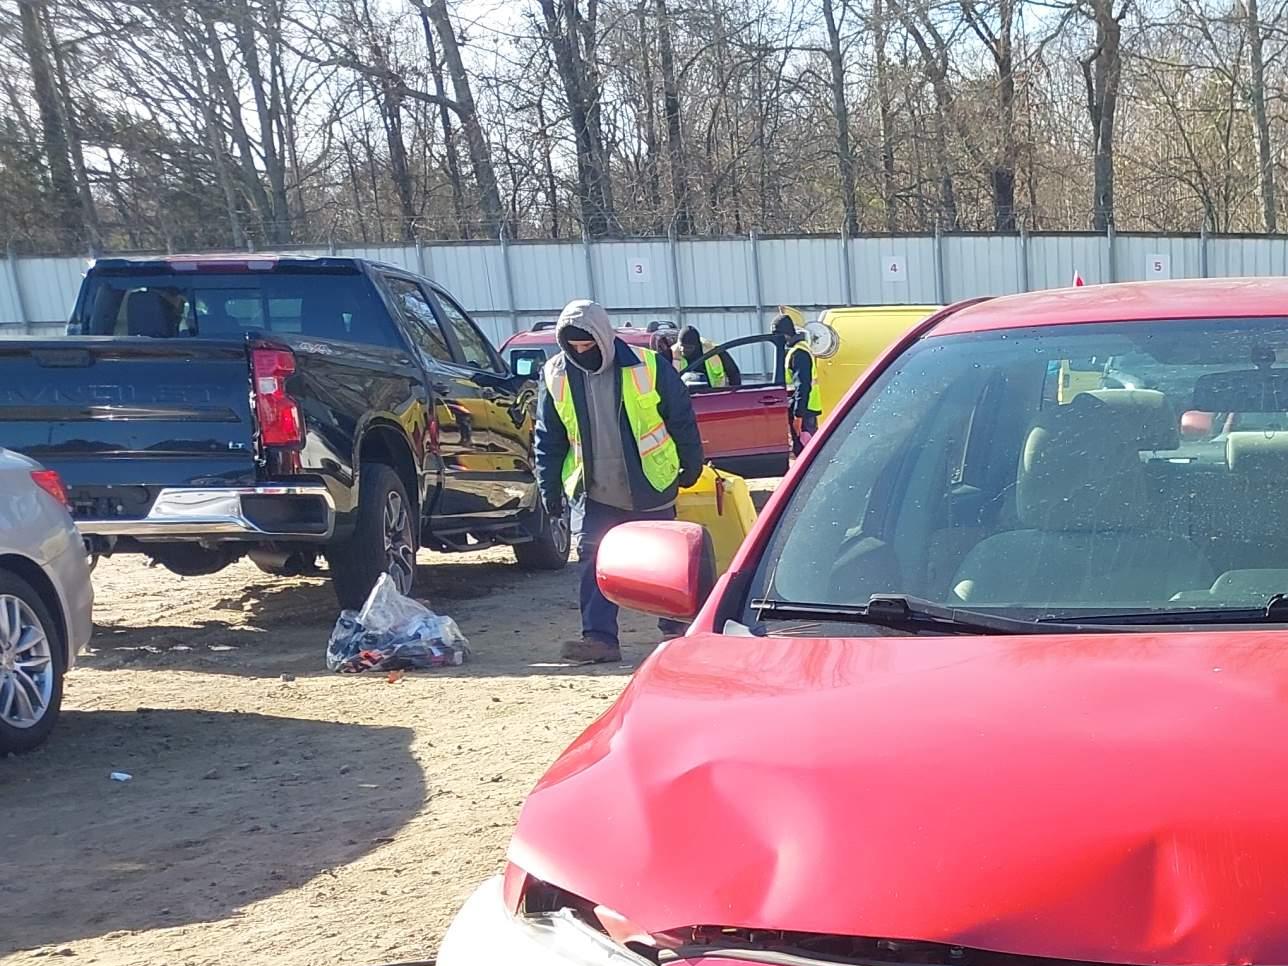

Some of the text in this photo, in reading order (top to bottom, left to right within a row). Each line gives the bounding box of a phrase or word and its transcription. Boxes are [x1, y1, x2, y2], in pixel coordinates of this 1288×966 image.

[635, 264, 643, 274] 3
[890, 263, 899, 273] 4
[1154, 261, 1162, 272] 5
